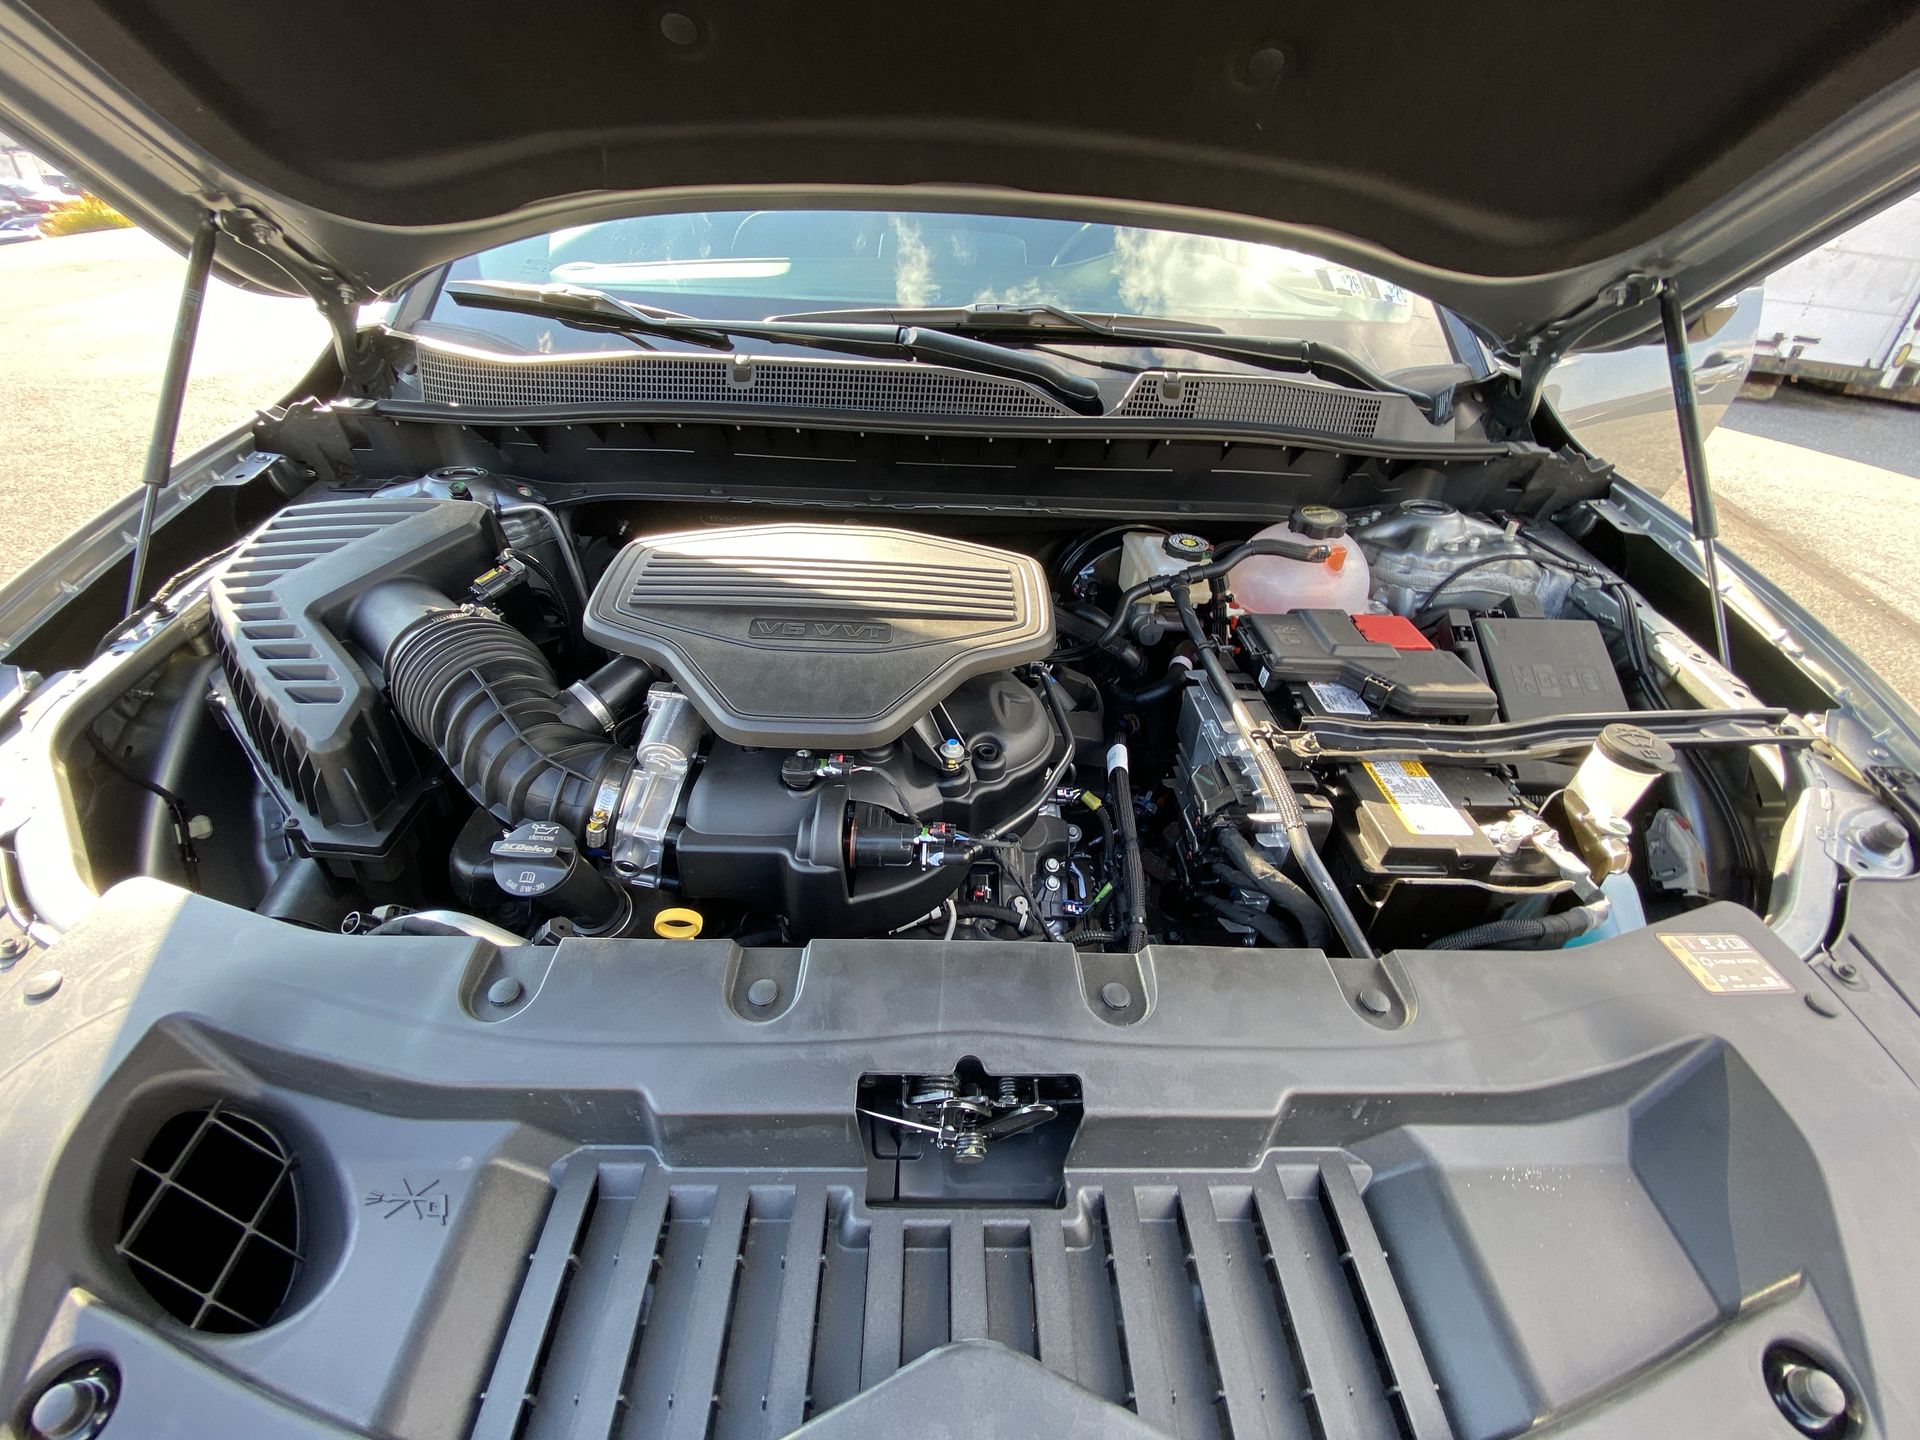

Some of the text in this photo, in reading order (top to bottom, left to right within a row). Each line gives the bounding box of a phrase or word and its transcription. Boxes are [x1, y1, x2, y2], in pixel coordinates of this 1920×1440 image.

[757, 621, 887, 638] V6 VVT
[500, 843, 553, 853] ACDelco
[506, 879, 545, 892] SAE 5W-30
